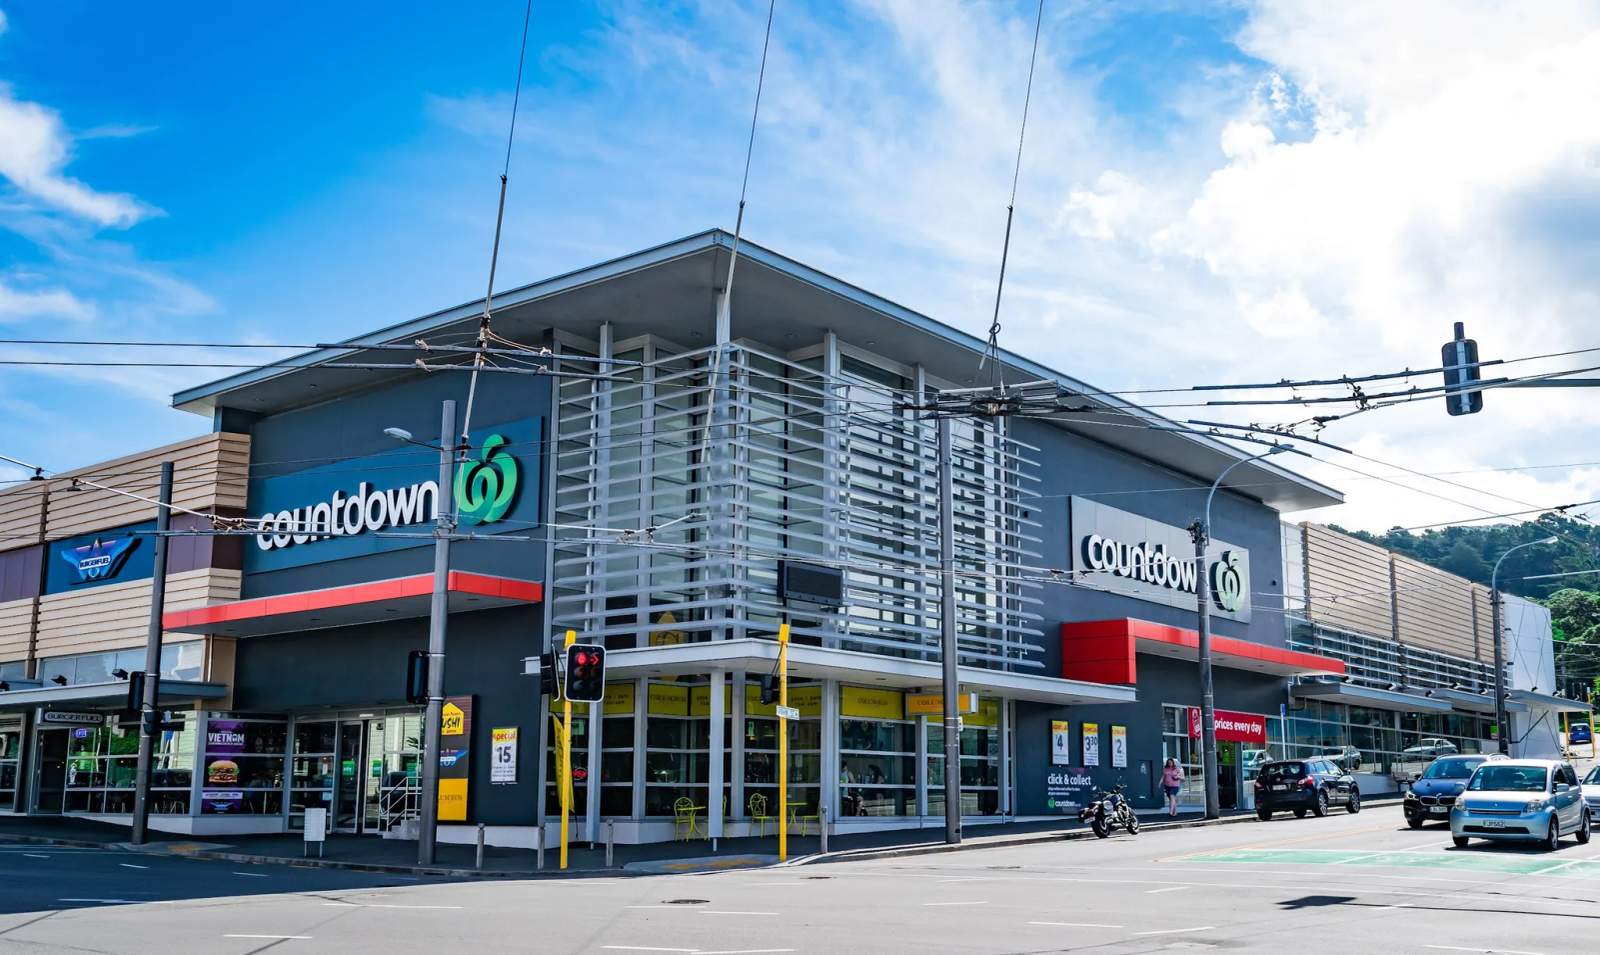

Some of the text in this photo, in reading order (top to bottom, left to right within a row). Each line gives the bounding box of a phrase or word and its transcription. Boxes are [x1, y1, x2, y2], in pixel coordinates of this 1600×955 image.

[257, 480, 438, 550] countdown
[1087, 534, 1197, 593] countdow
[442, 717, 461, 729] USHI
[1215, 718, 1233, 731] prices
[1234, 722, 1250, 735] every
[1251, 722, 1263, 736] day
[1048, 773, 1092, 786] click & collect
